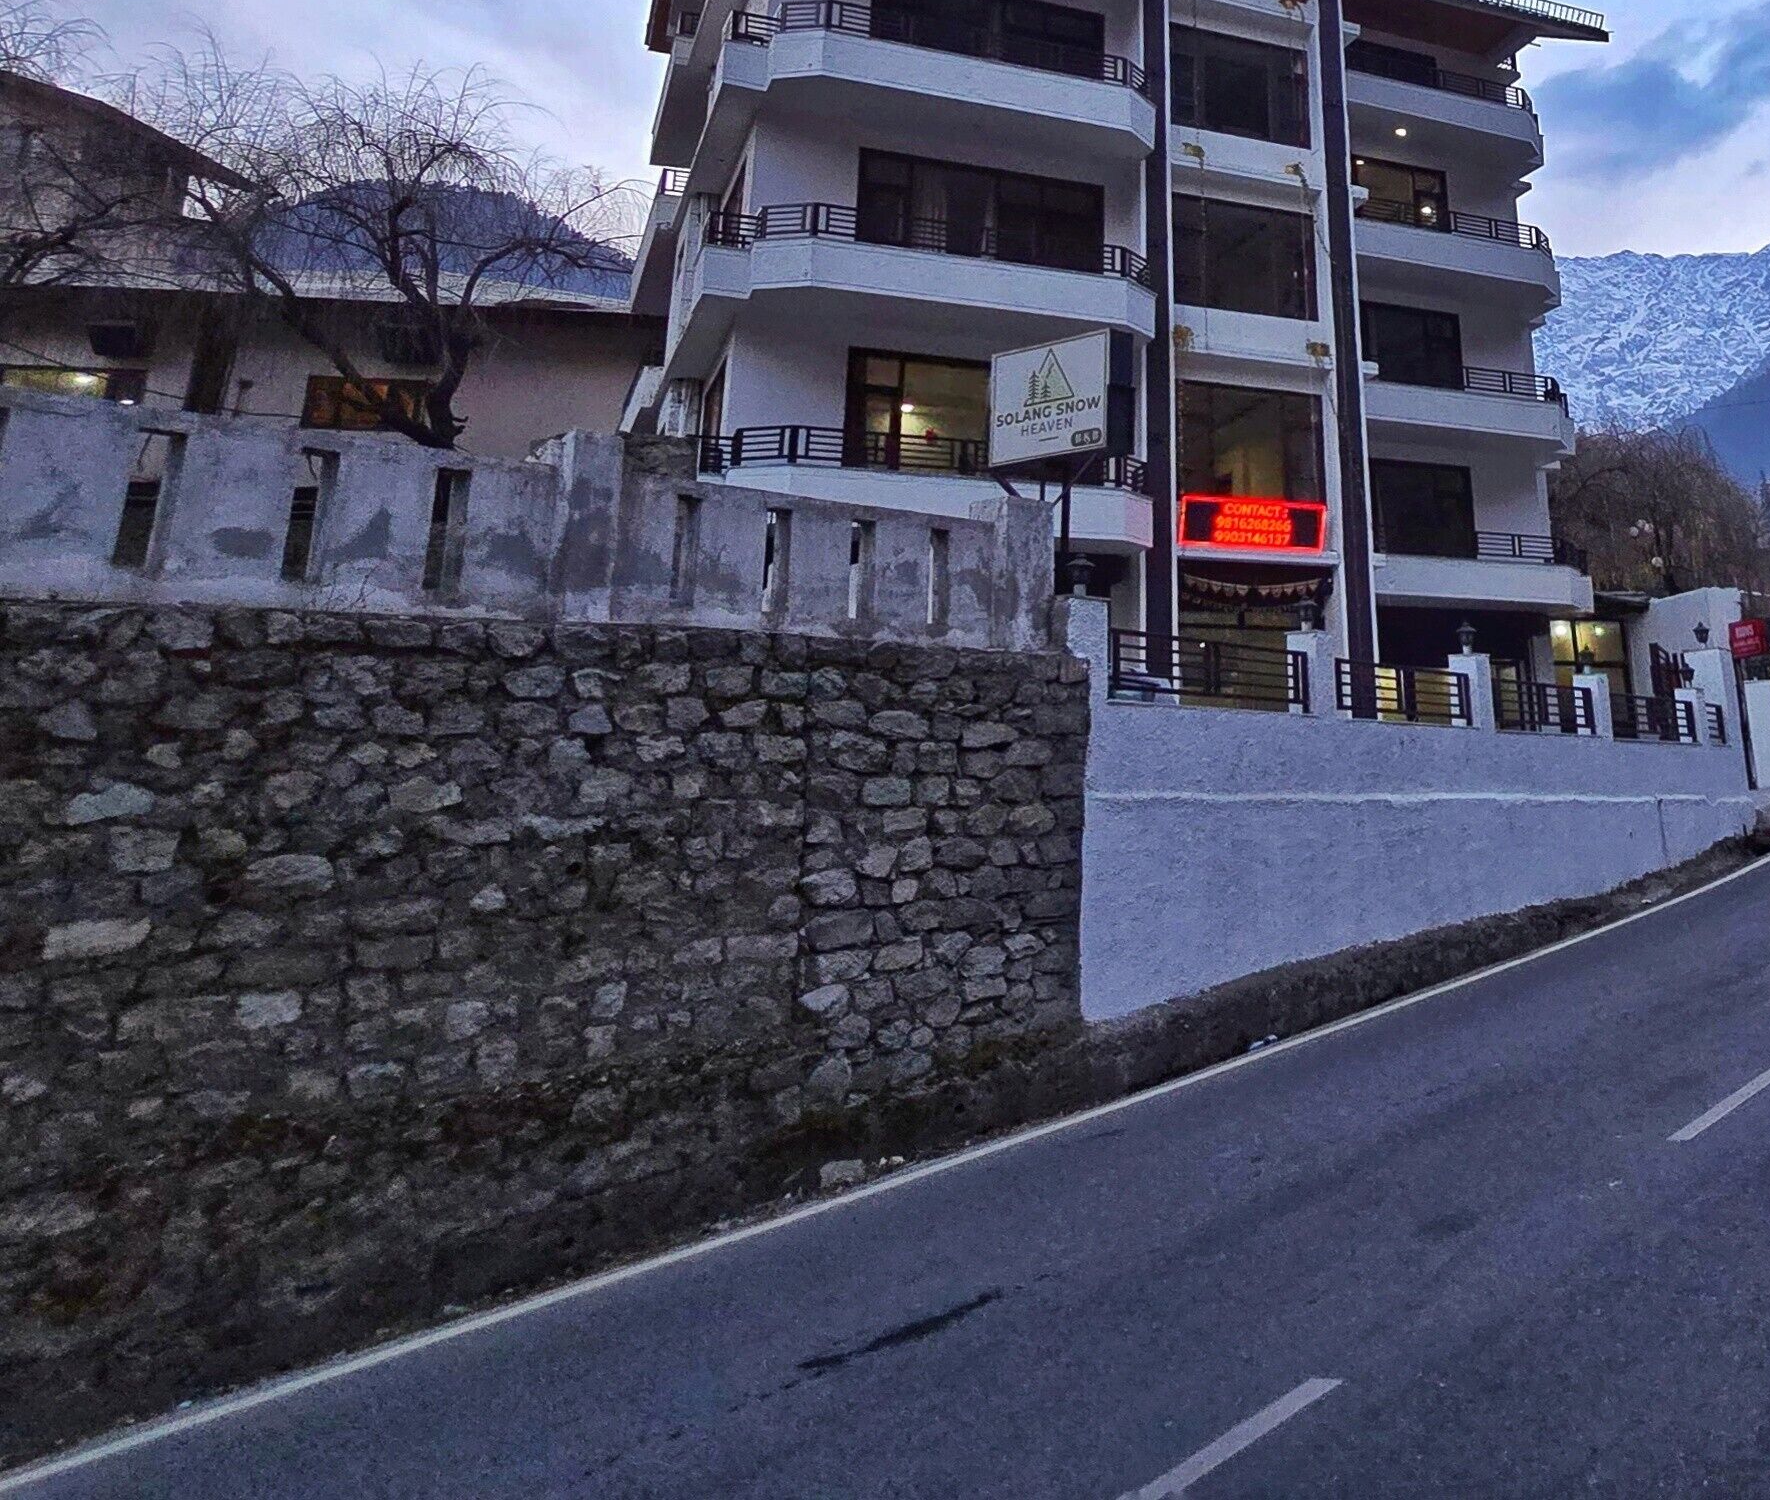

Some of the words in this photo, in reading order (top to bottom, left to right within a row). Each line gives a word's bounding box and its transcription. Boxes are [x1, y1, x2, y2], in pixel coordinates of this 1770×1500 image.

[996, 405, 1052, 428] SOLANG
[1056, 395, 1101, 416] SNOW
[1020, 415, 1074, 437] HEAVEN
